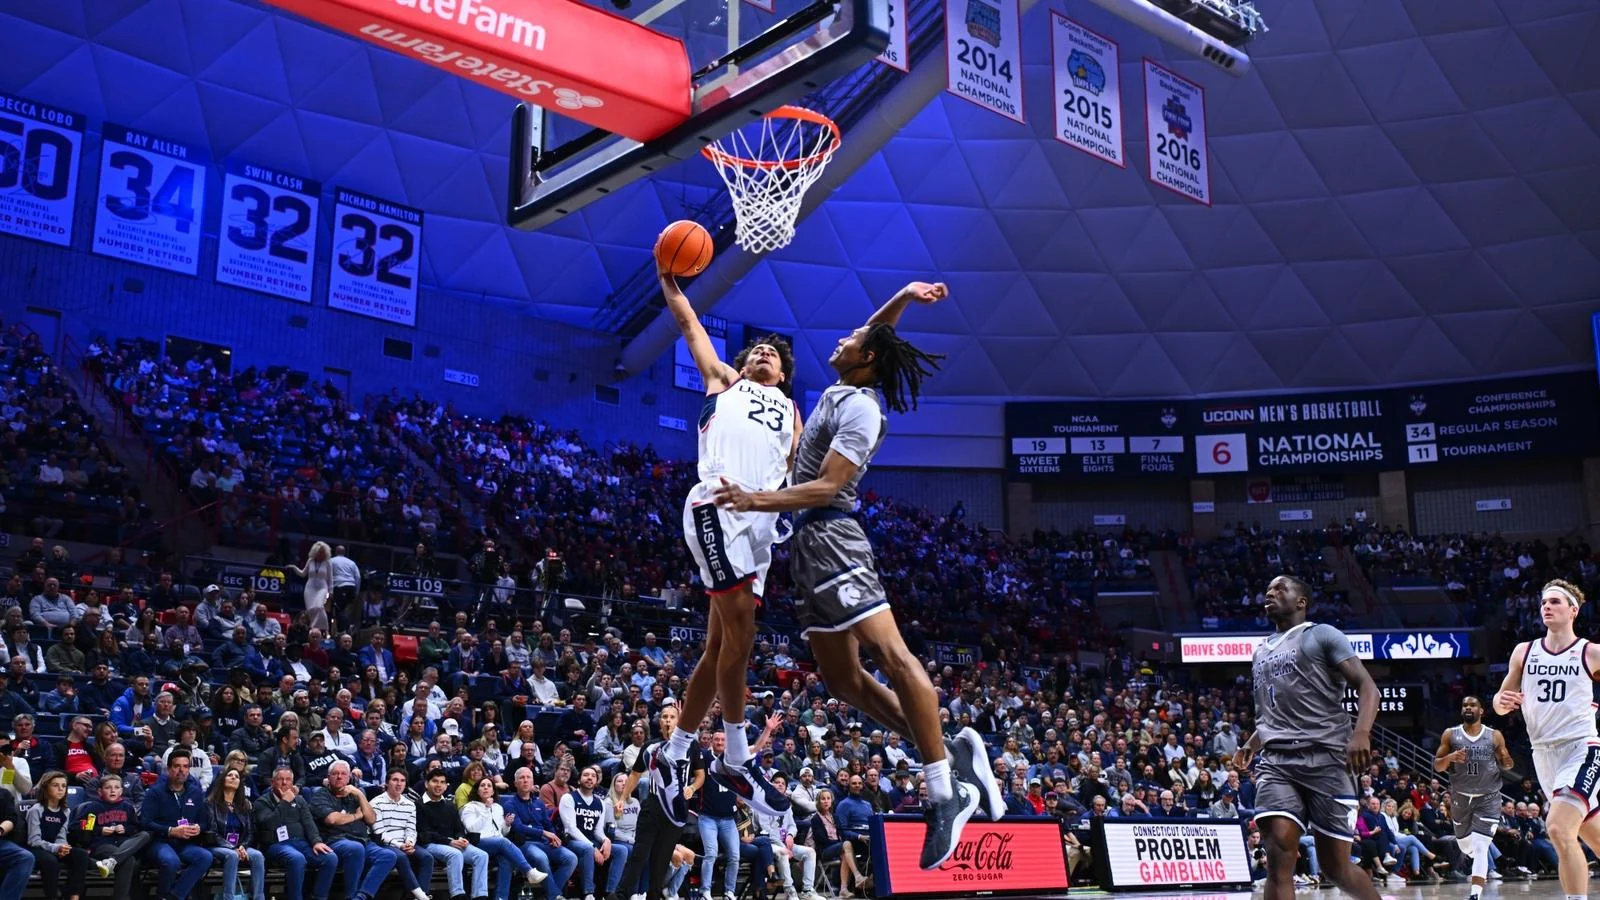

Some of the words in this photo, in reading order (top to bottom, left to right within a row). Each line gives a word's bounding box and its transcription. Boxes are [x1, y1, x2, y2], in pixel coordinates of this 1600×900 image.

[957, 39, 1013, 83] 2014
[961, 68, 1010, 99] NATIONAL
[957, 82, 1016, 115] CHAMPIONS
[1063, 89, 1112, 129] 2015
[41, 107, 73, 126] LOBO
[1067, 117, 1112, 144] NATIONAL
[126, 132, 150, 146] RAY
[152, 139, 187, 158] ALLEN
[1064, 130, 1116, 160] CHAMPIONS
[1157, 133, 1201, 171] 2016
[245, 165, 273, 183] SWIN
[276, 174, 303, 191] CASH
[1160, 159, 1200, 184] NATIONAL
[105, 151, 195, 234] 34
[1157, 171, 1203, 199] CHAMPIONS
[339, 191, 377, 210] RICHARD
[379, 203, 420, 223] HAMILTON
[16, 216, 66, 235] RETIRED
[227, 184, 311, 264] 32
[99, 237, 144, 253] NUMBER
[148, 247, 193, 264] RETIRED
[338, 213, 414, 290] 32
[222, 265, 263, 281] NUMBER
[266, 276, 307, 293] RETIRED
[333, 292, 370, 306] NUMBER
[373, 301, 411, 316] RETIRED
[461, 374, 478, 385] 210
[1468, 400, 1556, 414] CHAMPIONSHIPS
[1475, 390, 1547, 404] CONFERENCE
[748, 399, 784, 432] 23
[1071, 415, 1099, 423] NCAA
[1203, 409, 1254, 423] UCONN
[1259, 405, 1298, 423] MEN'S
[1302, 400, 1382, 421] BASKETBALL
[1053, 425, 1119, 433] TOURNAMENT
[1411, 427, 1431, 439] 34
[1440, 421, 1500, 436] REGULAR
[1504, 417, 1558, 430] SEASON
[1031, 440, 1047, 451] 19
[1090, 440, 1105, 451] 13
[1151, 439, 1160, 450] 7
[1212, 441, 1232, 465] 6
[1259, 432, 1382, 453] NATIONAL
[1416, 447, 1429, 460] 11
[1442, 441, 1533, 456] TOURNAMENT
[1020, 456, 1060, 465] SWEET
[1083, 455, 1114, 464] ELITE
[1141, 455, 1174, 463] FINAL
[1259, 449, 1383, 466] CHAMPIONSHIPS
[1020, 465, 1060, 473] SIXTEENS
[700, 508, 727, 581] HUSKIES
[224, 576, 243, 585] SEC
[250, 576, 279, 591] 108
[392, 579, 410, 588] SEC
[415, 578, 442, 593] 109
[771, 634, 789, 646] 110
[1183, 644, 1215, 656] DRIVE
[1217, 643, 1252, 655] SOBER
[1527, 665, 1579, 676] UCONN
[1268, 684, 1276, 709] 1
[1537, 679, 1566, 703] 30
[1466, 761, 1479, 776] 11
[576, 808, 602, 818] UCONN
[584, 817, 595, 830] 13
[1133, 825, 1179, 837] CONNECTICUT
[1181, 825, 1208, 837] COUNCIL
[1209, 829, 1218, 837] on
[1135, 838, 1221, 861] PROBLEM
[1140, 861, 1226, 883] GAMBLING
